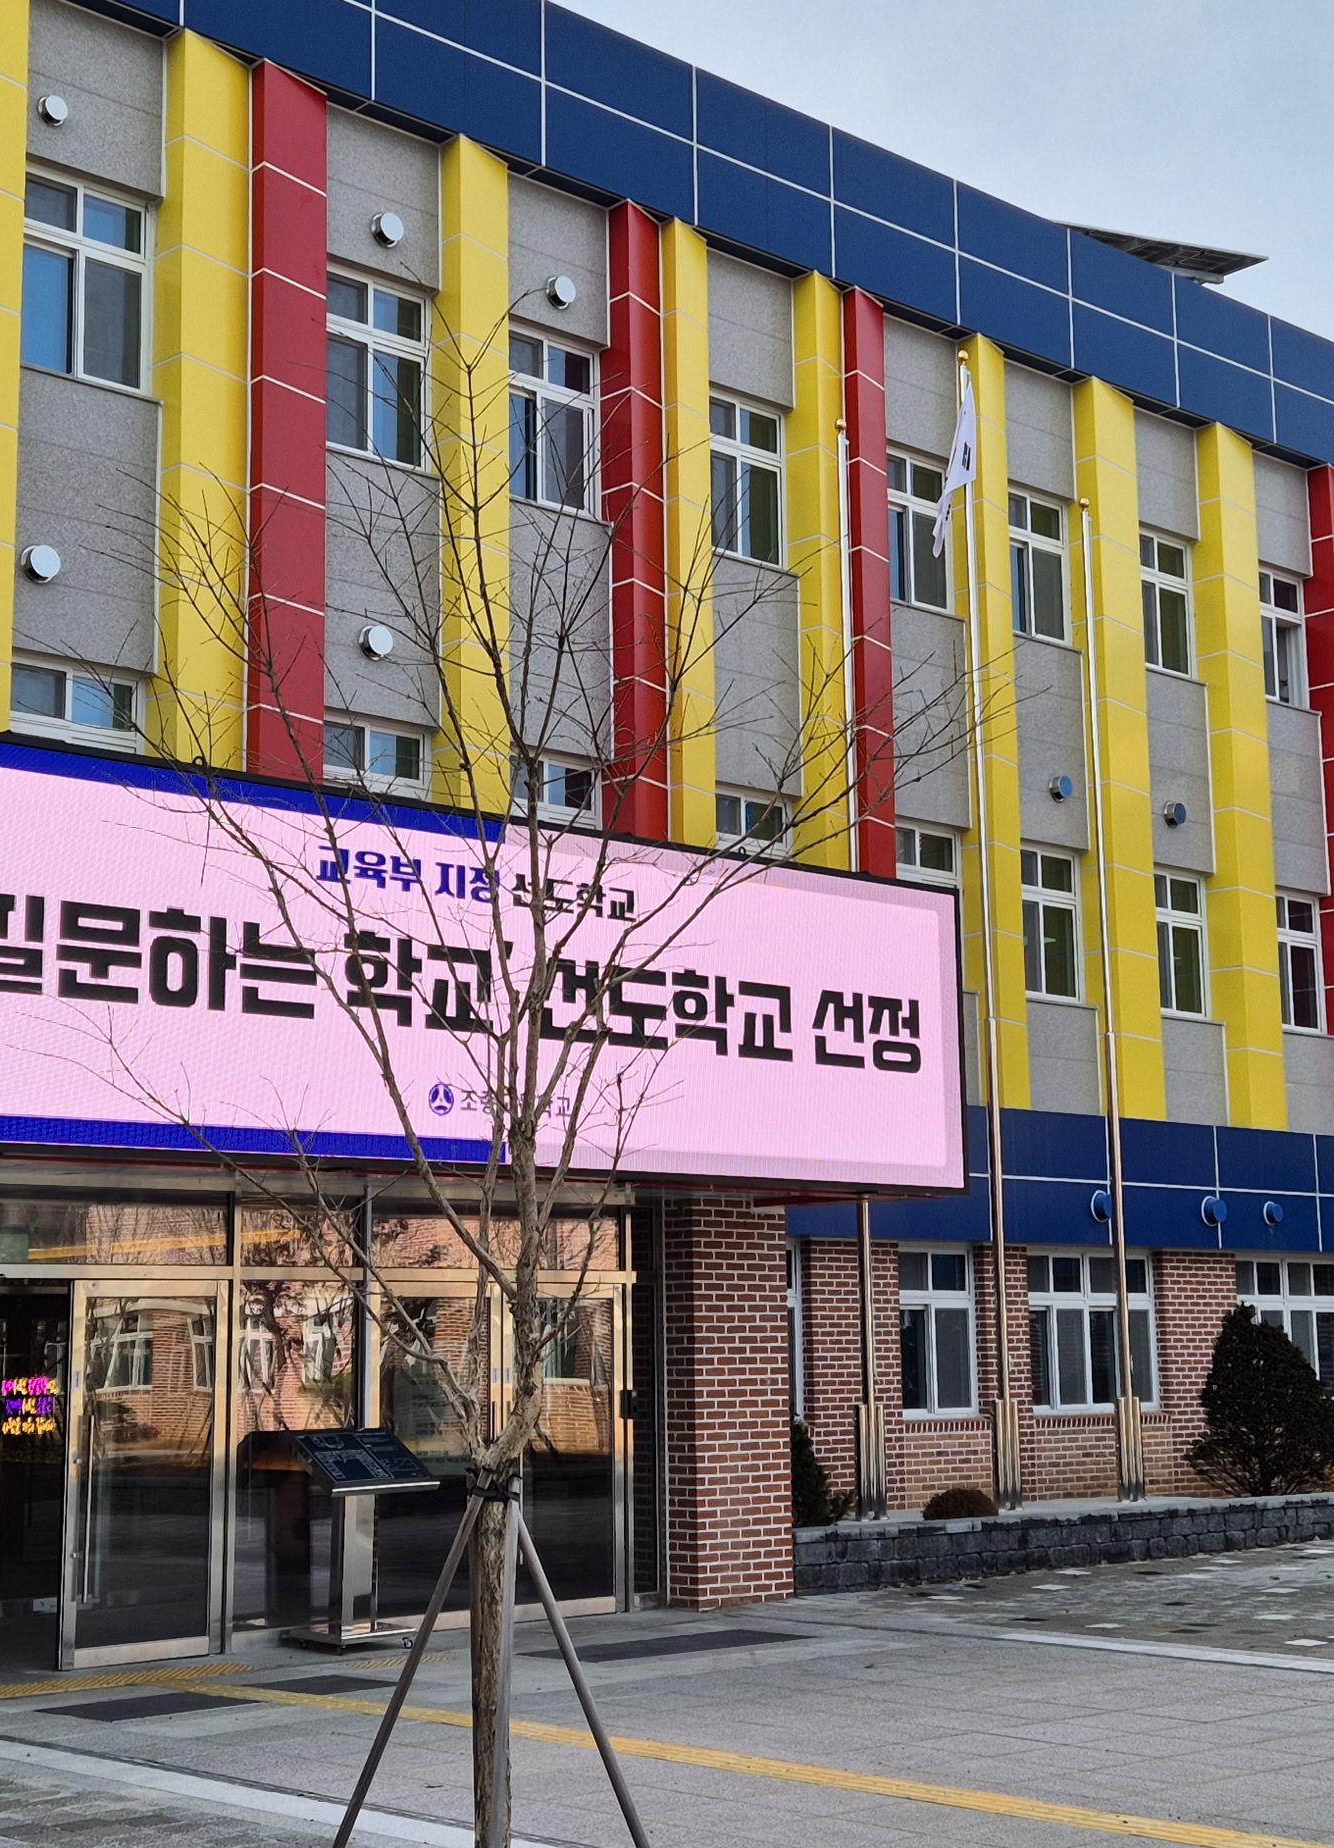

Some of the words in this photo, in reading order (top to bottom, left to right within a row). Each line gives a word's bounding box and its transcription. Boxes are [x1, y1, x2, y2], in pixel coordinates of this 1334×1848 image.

[317, 845, 422, 892] 교육부
[434, 861, 501, 904] 지정
[511, 873, 638, 922] 선도학교
[540, 957, 794, 1063] 선도학교
[811, 988, 922, 1075] 선정
